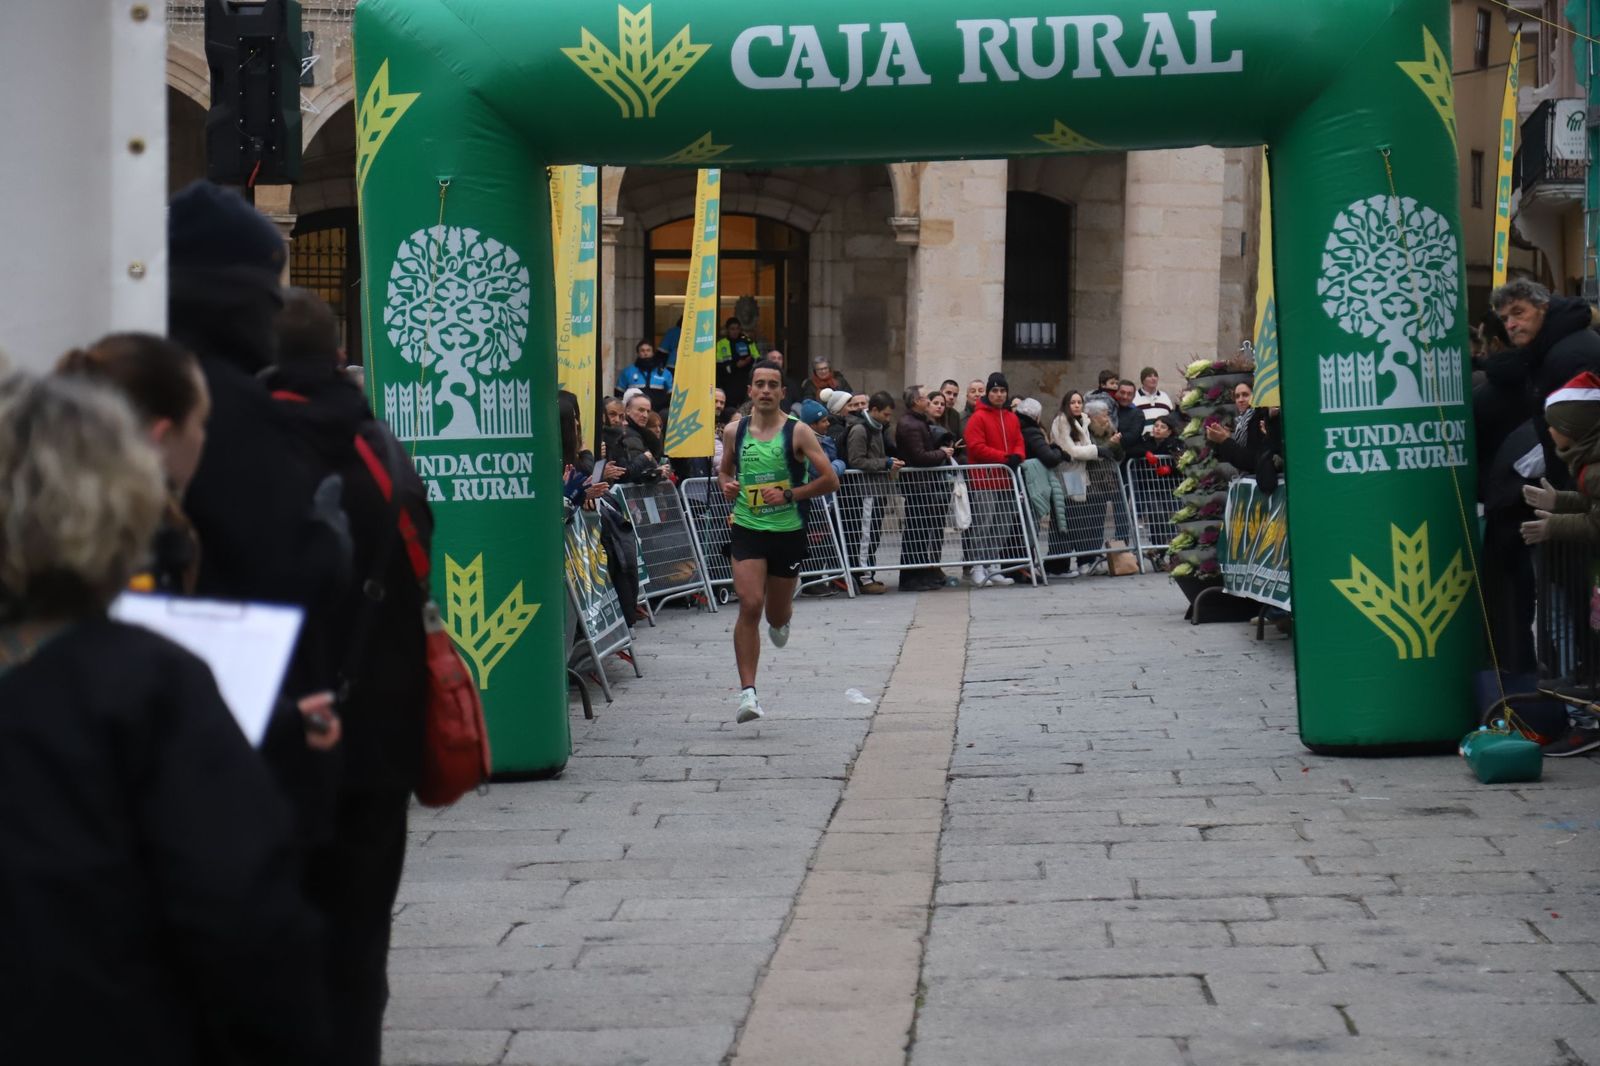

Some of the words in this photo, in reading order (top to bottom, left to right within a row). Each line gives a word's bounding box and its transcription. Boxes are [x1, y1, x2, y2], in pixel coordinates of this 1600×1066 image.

[730, 22, 932, 92] CAJA
[956, 9, 1243, 83] RURAL
[1324, 420, 1466, 449] FUNDACION
[411, 452, 534, 477] NDACION
[1326, 449, 1392, 474] CAJA
[1396, 445, 1469, 470] RURAL
[451, 477, 536, 501] RURAL
